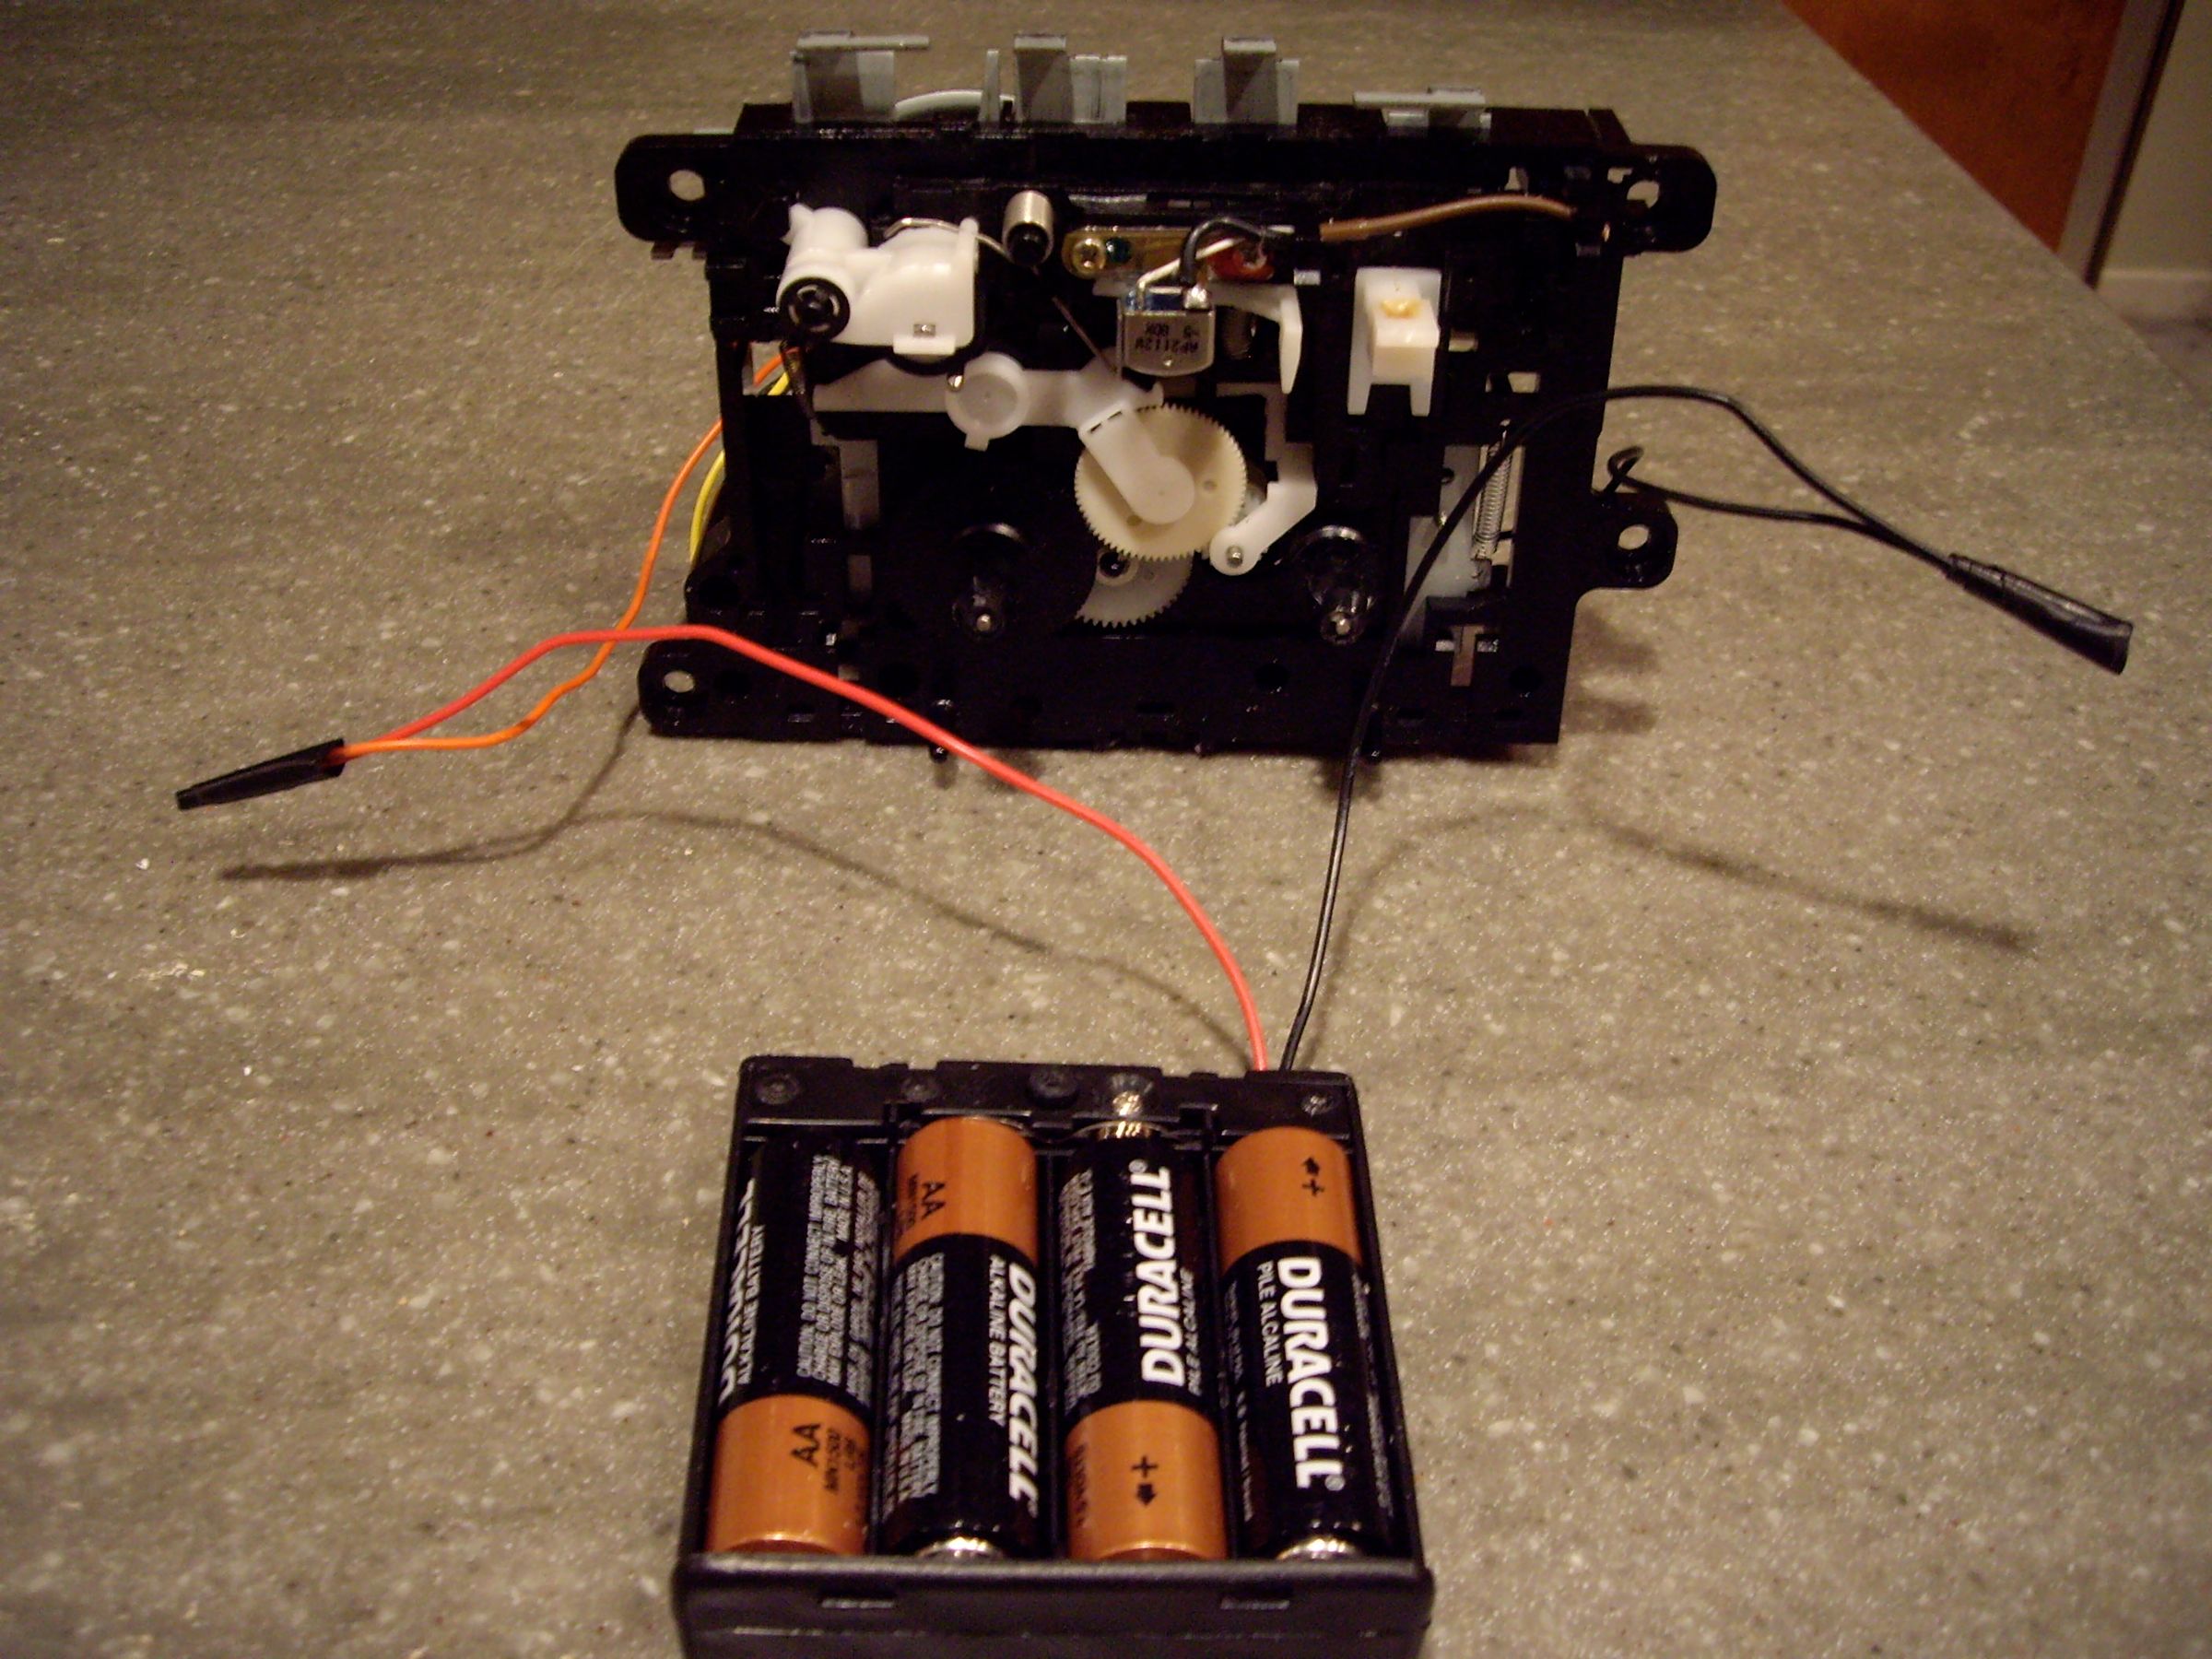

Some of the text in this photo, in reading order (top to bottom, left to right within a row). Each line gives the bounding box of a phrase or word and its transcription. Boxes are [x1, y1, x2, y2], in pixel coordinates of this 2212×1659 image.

[920, 1181, 946, 1220] AA
[1130, 1167, 1185, 1386] DURACELL
[737, 1224, 765, 1384] ALKALINE BATTERY
[988, 1255, 1006, 1428] ALKALINE BATTERY
[1008, 1264, 1038, 1503] DURACELL
[1256, 1261, 1283, 1387] PILE ALCALINE
[1277, 1256, 1343, 1489] DURACELL
[791, 1423, 820, 1467] AA
